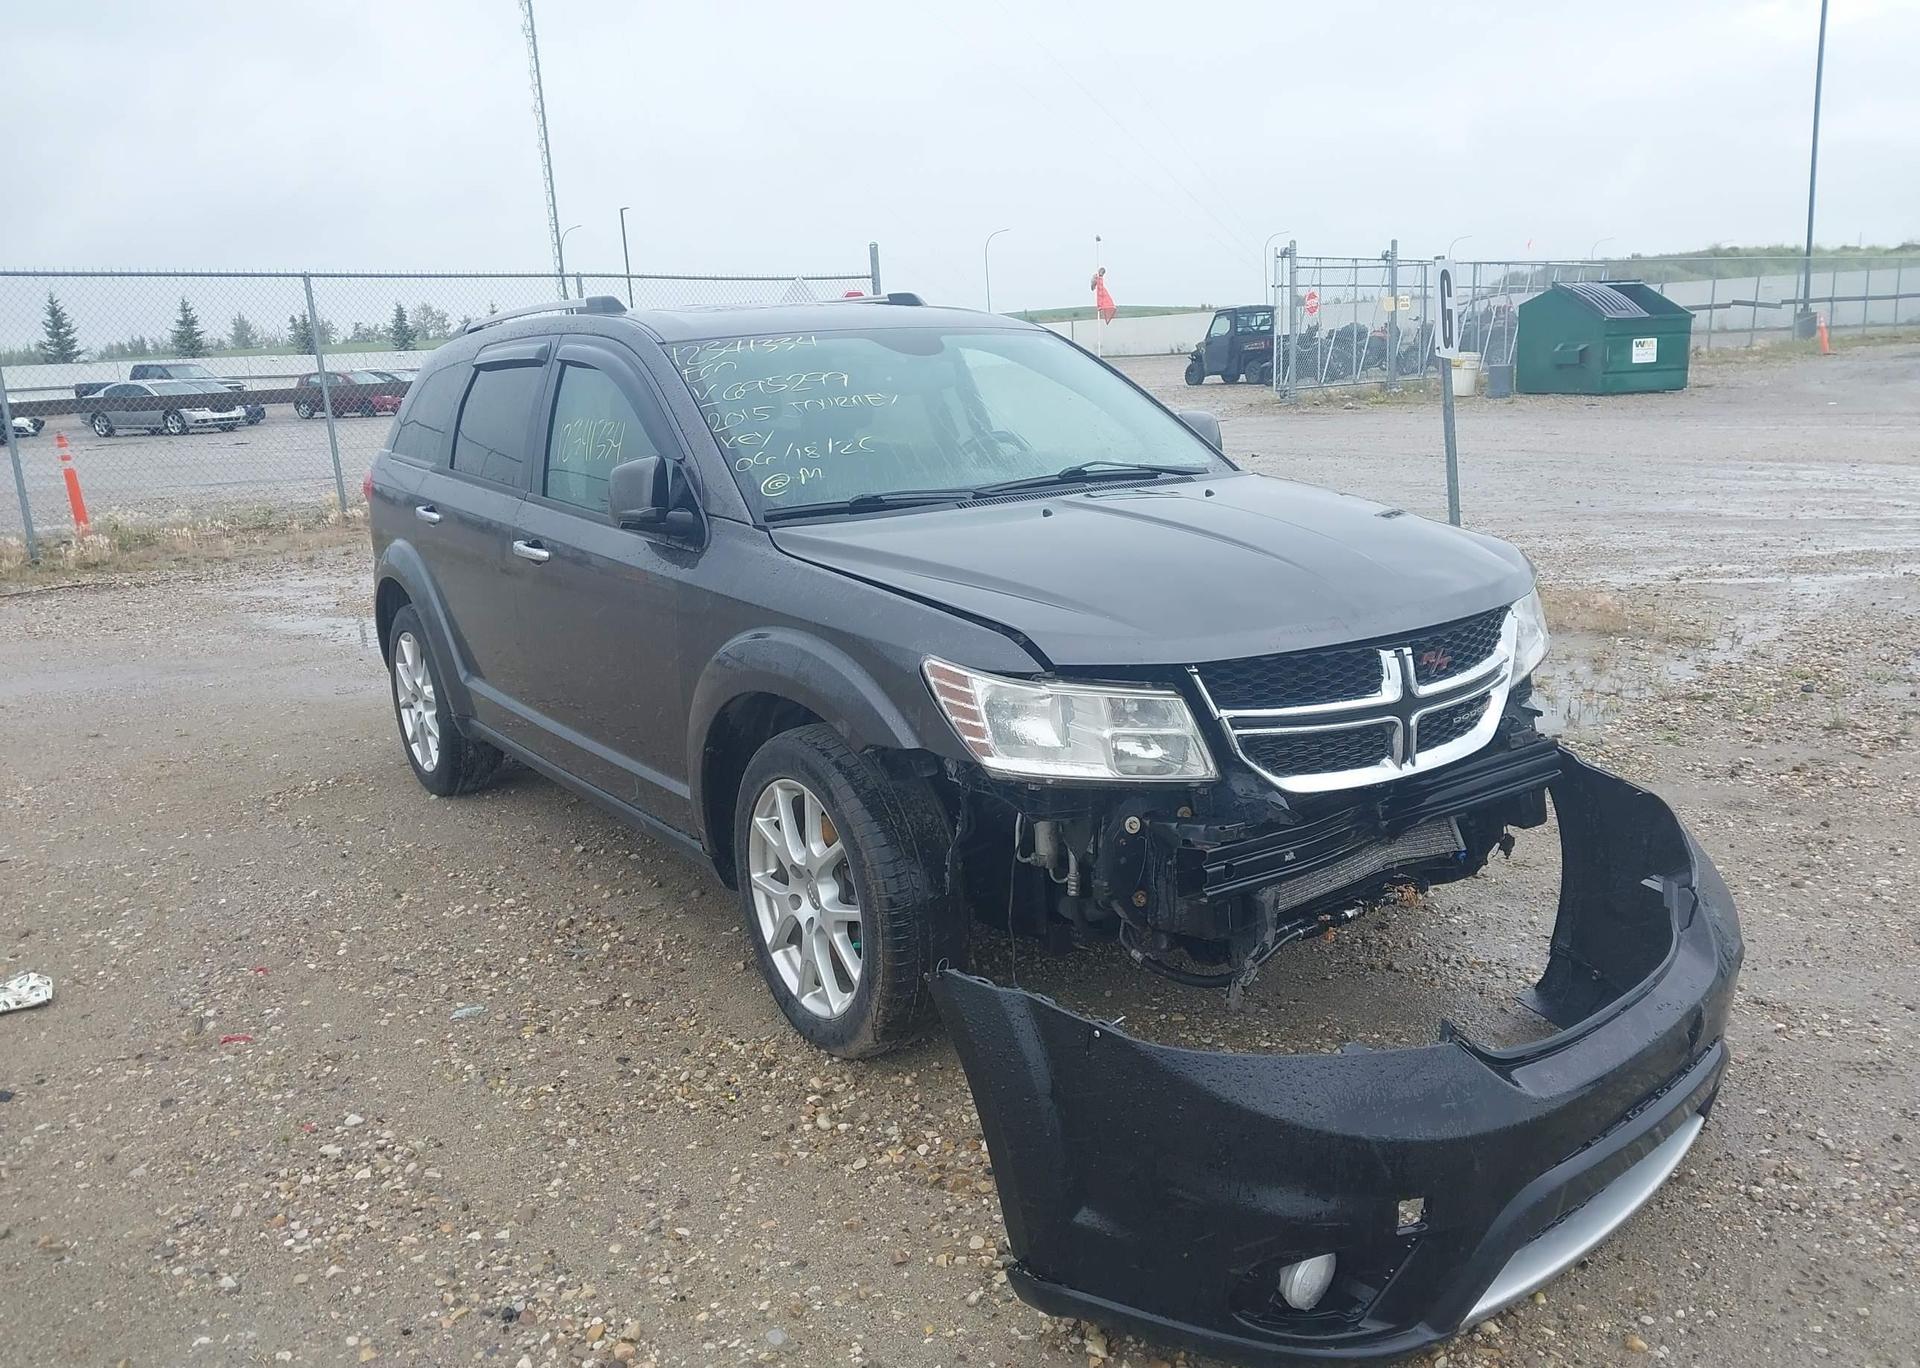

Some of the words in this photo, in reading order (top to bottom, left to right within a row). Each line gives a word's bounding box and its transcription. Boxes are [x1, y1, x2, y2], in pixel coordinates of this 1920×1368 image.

[1440, 268, 1454, 350] G
[707, 405, 777, 433] 2015
[719, 429, 775, 449] KEY
